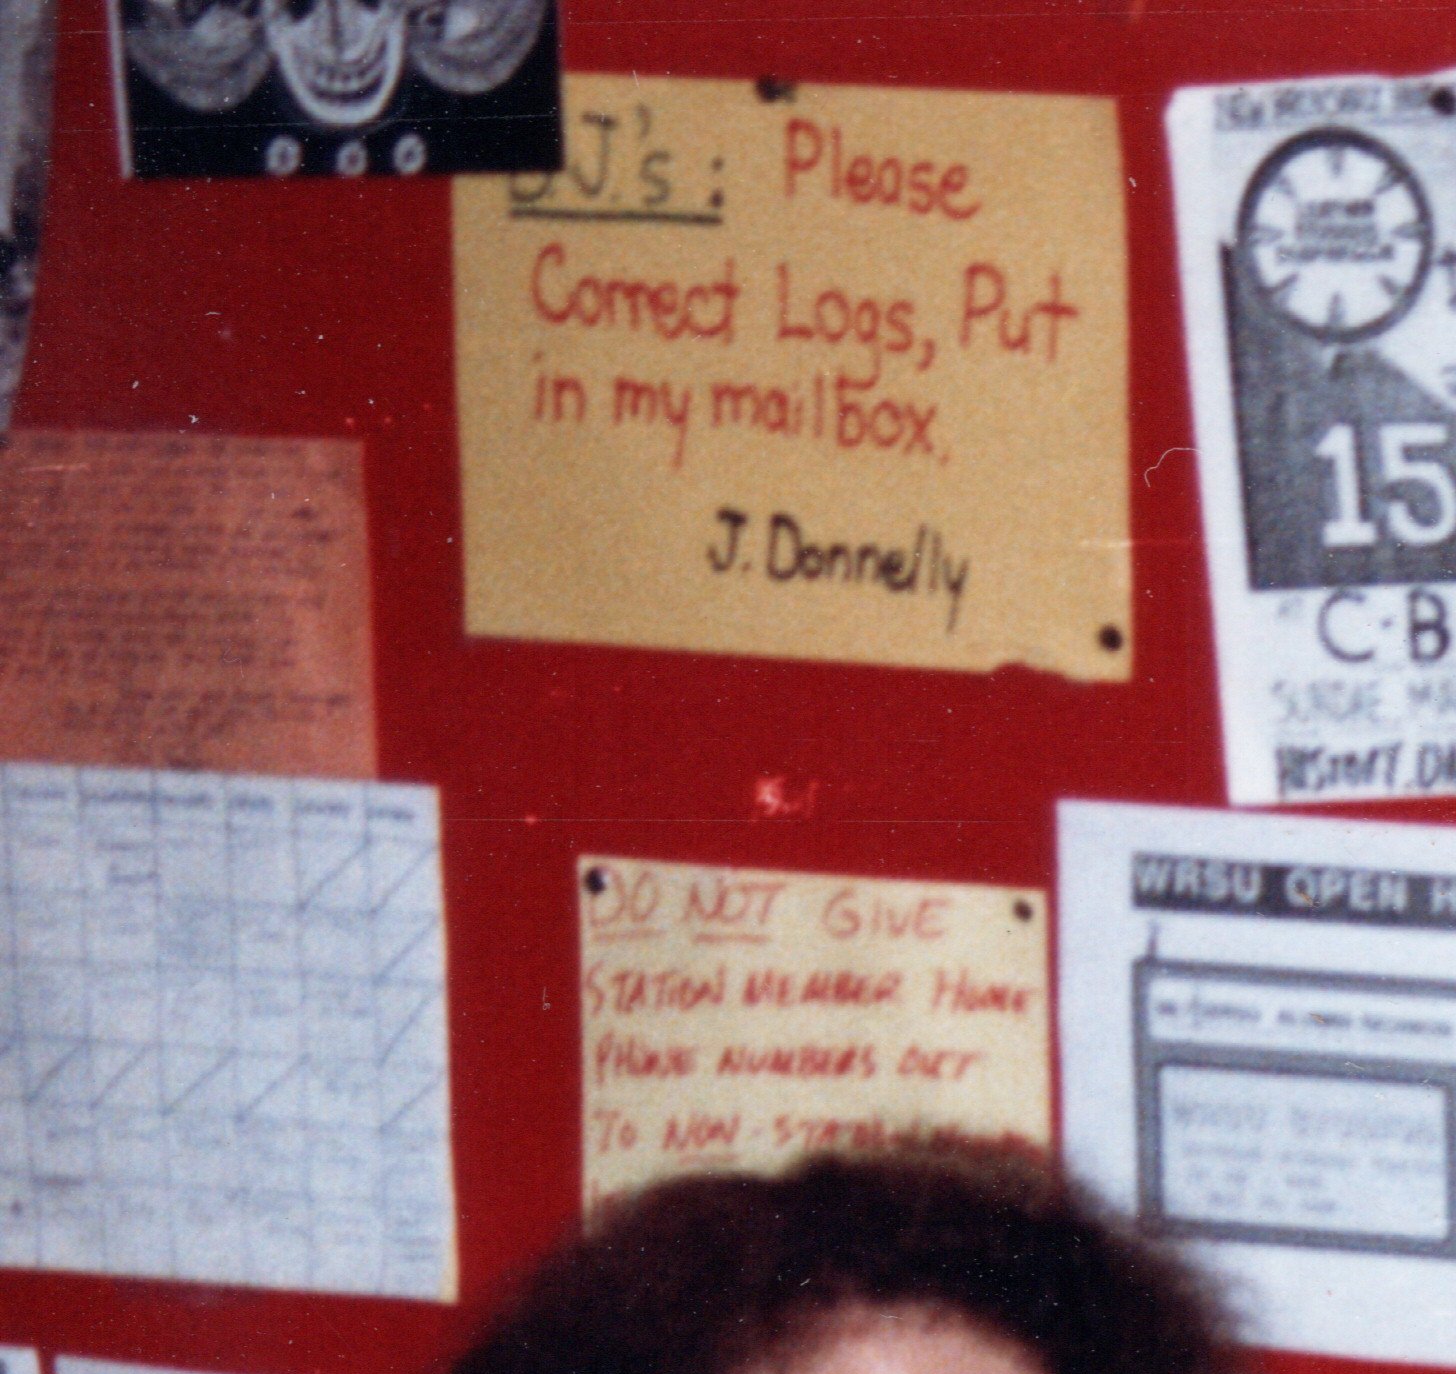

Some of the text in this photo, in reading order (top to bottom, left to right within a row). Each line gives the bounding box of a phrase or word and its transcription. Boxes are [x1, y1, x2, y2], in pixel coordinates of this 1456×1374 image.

[786, 116, 984, 222] Please
[532, 242, 1078, 392] Correct Logs, Put
[531, 350, 952, 470] in my mailbox.
[707, 506, 970, 634] J. Donnelly
[586, 866, 950, 940] DO NOT GIVE
[1135, 855, 1263, 904] WRSU
[1286, 866, 1412, 914] OPEN
[586, 960, 1038, 1018] STATION MEMBER HOME
[716, 1042, 878, 1080] NUMBERS
[896, 1044, 980, 1082] OUT
[590, 1112, 638, 1154] TO
